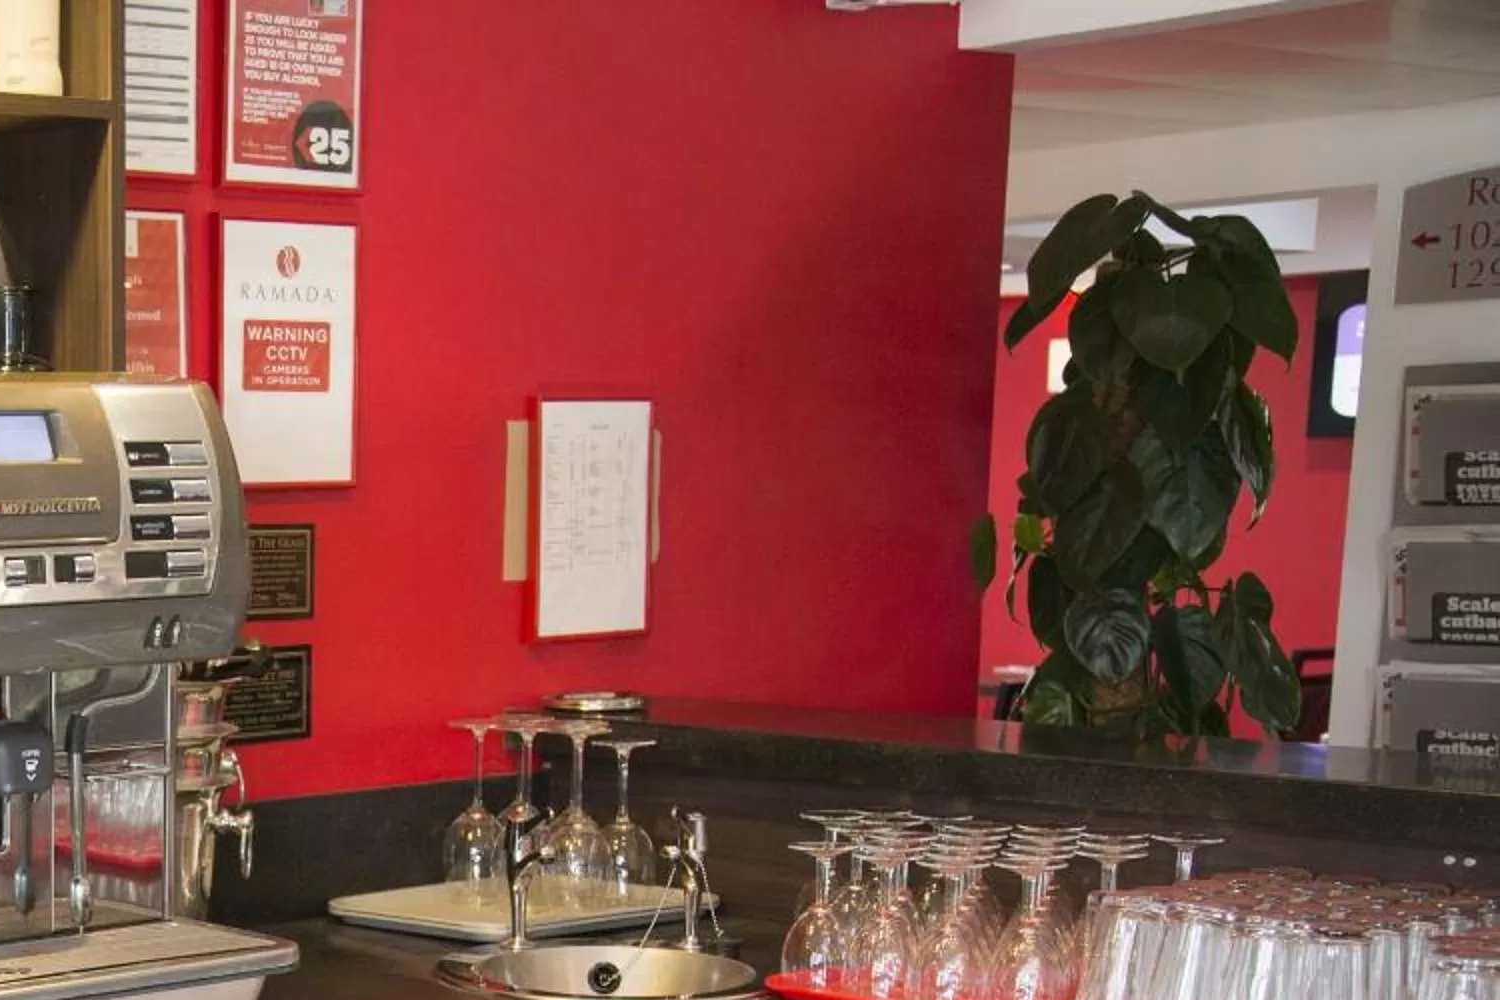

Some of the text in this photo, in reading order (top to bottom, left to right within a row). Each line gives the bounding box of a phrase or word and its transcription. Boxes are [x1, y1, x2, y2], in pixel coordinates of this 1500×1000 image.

[308, 126, 350, 165] 25
[240, 282, 338, 304] RAMADA
[247, 326, 327, 344] WARNING
[265, 345, 309, 361] CCTV
[263, 363, 309, 375] CAMERAS
[266, 376, 321, 386] OPERATION
